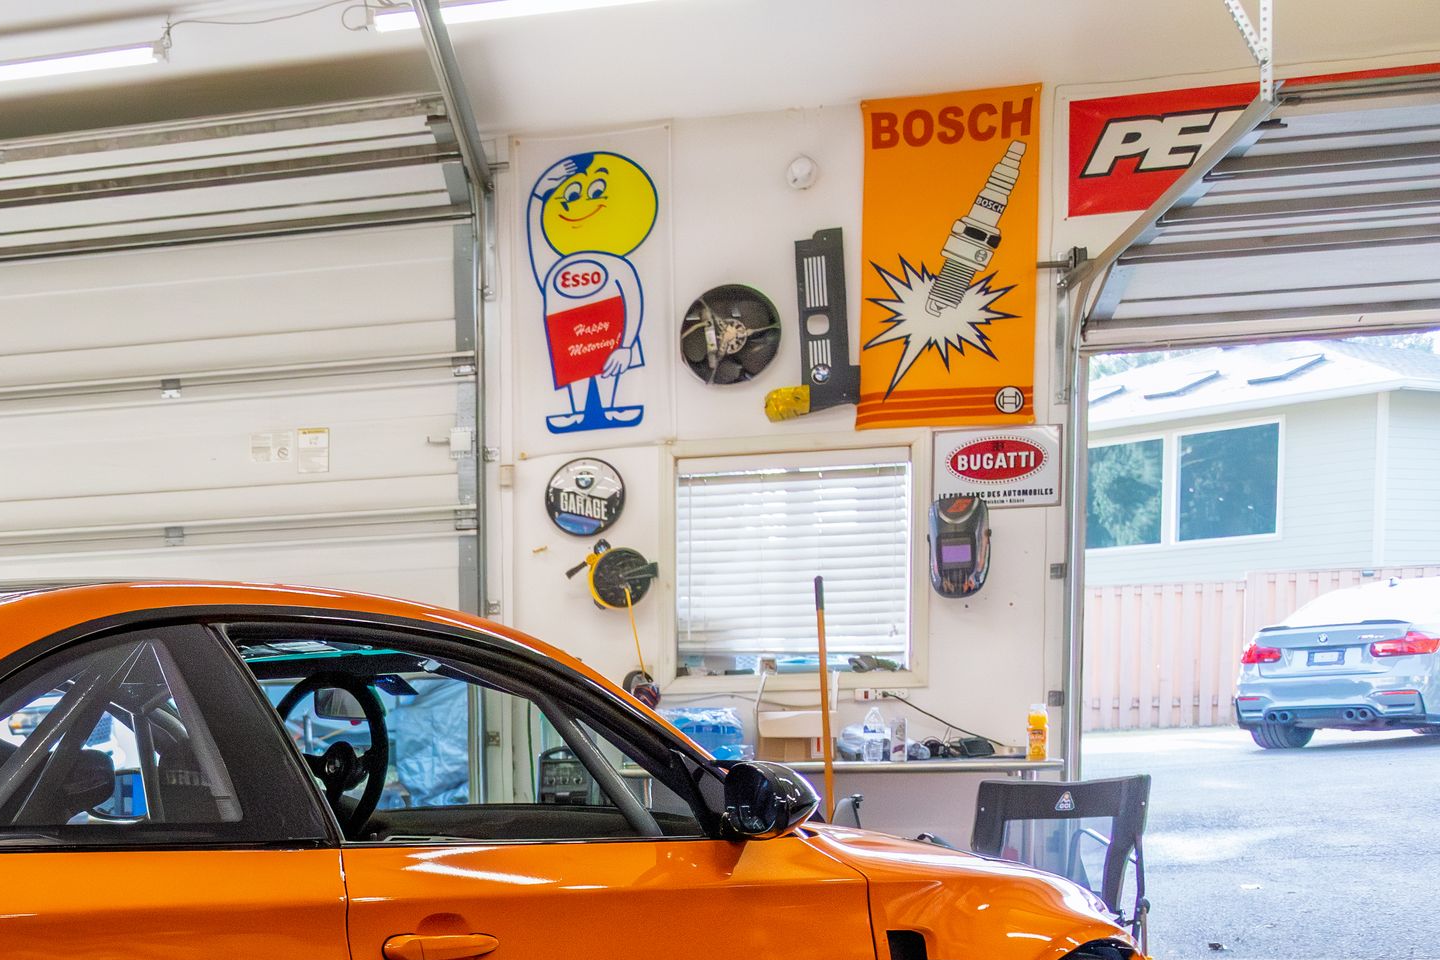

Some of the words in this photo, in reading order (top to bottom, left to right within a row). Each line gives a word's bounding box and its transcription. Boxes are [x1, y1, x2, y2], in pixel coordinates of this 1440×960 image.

[870, 97, 1033, 149] BOSCH
[976, 197, 1005, 214] BOSCH
[561, 271, 601, 288] Esso
[573, 322, 610, 337] Happy
[568, 333, 621, 357] Motoring!
[957, 451, 1035, 471] BUGATTI
[987, 489, 1001, 498] DES
[1003, 488, 1054, 497] AUTOMOBILES
[560, 491, 608, 520] GARAGE
